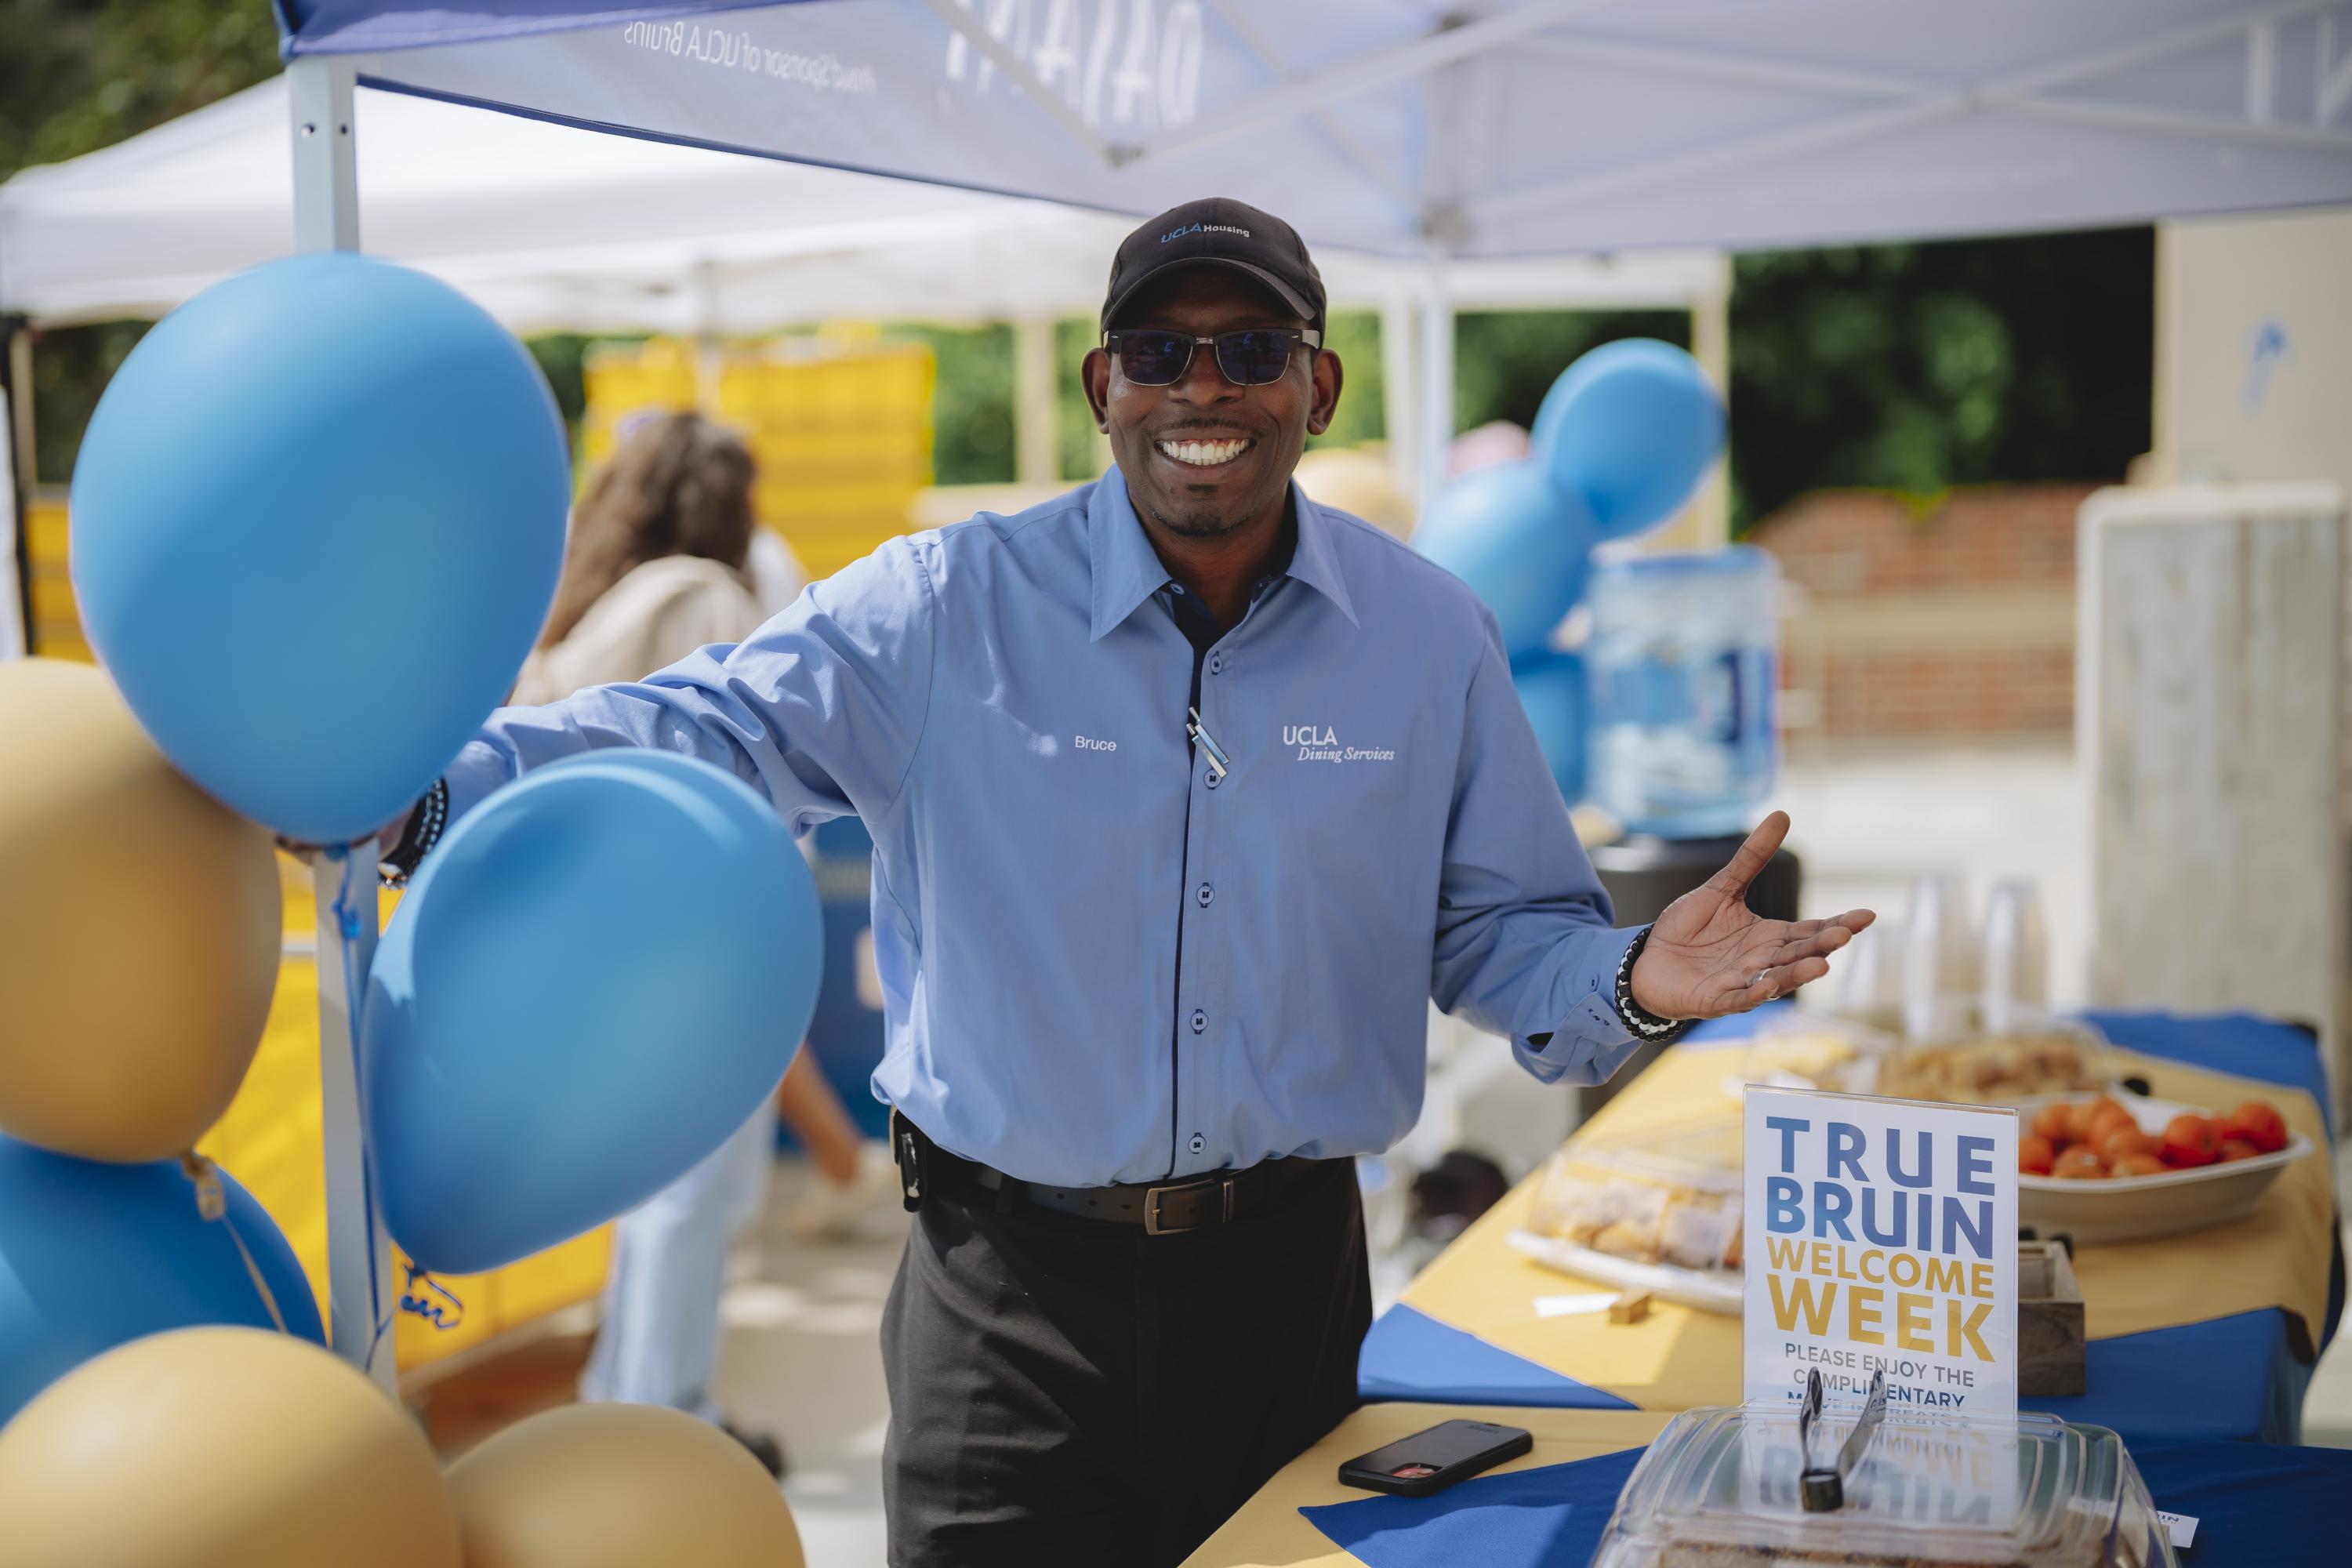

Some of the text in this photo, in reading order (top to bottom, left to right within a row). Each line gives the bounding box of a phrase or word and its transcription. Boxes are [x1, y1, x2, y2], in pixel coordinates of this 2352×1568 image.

[1161, 223, 1250, 243] UCLA Housing
[1075, 735, 1117, 751] Bruce
[1283, 726, 1338, 746] UCLA
[1297, 746, 1396, 763] Dining Services
[1766, 1116, 1994, 1196] TRUE
[1767, 1176, 1993, 1260] BRUIN
[1766, 1236, 1994, 1299] WELCOME
[1766, 1274, 1995, 1362] WEEK
[1786, 1342, 1973, 1388] PLEASE ENJOY THE
[1794, 1369, 1965, 1407] CMPLIENTARY
